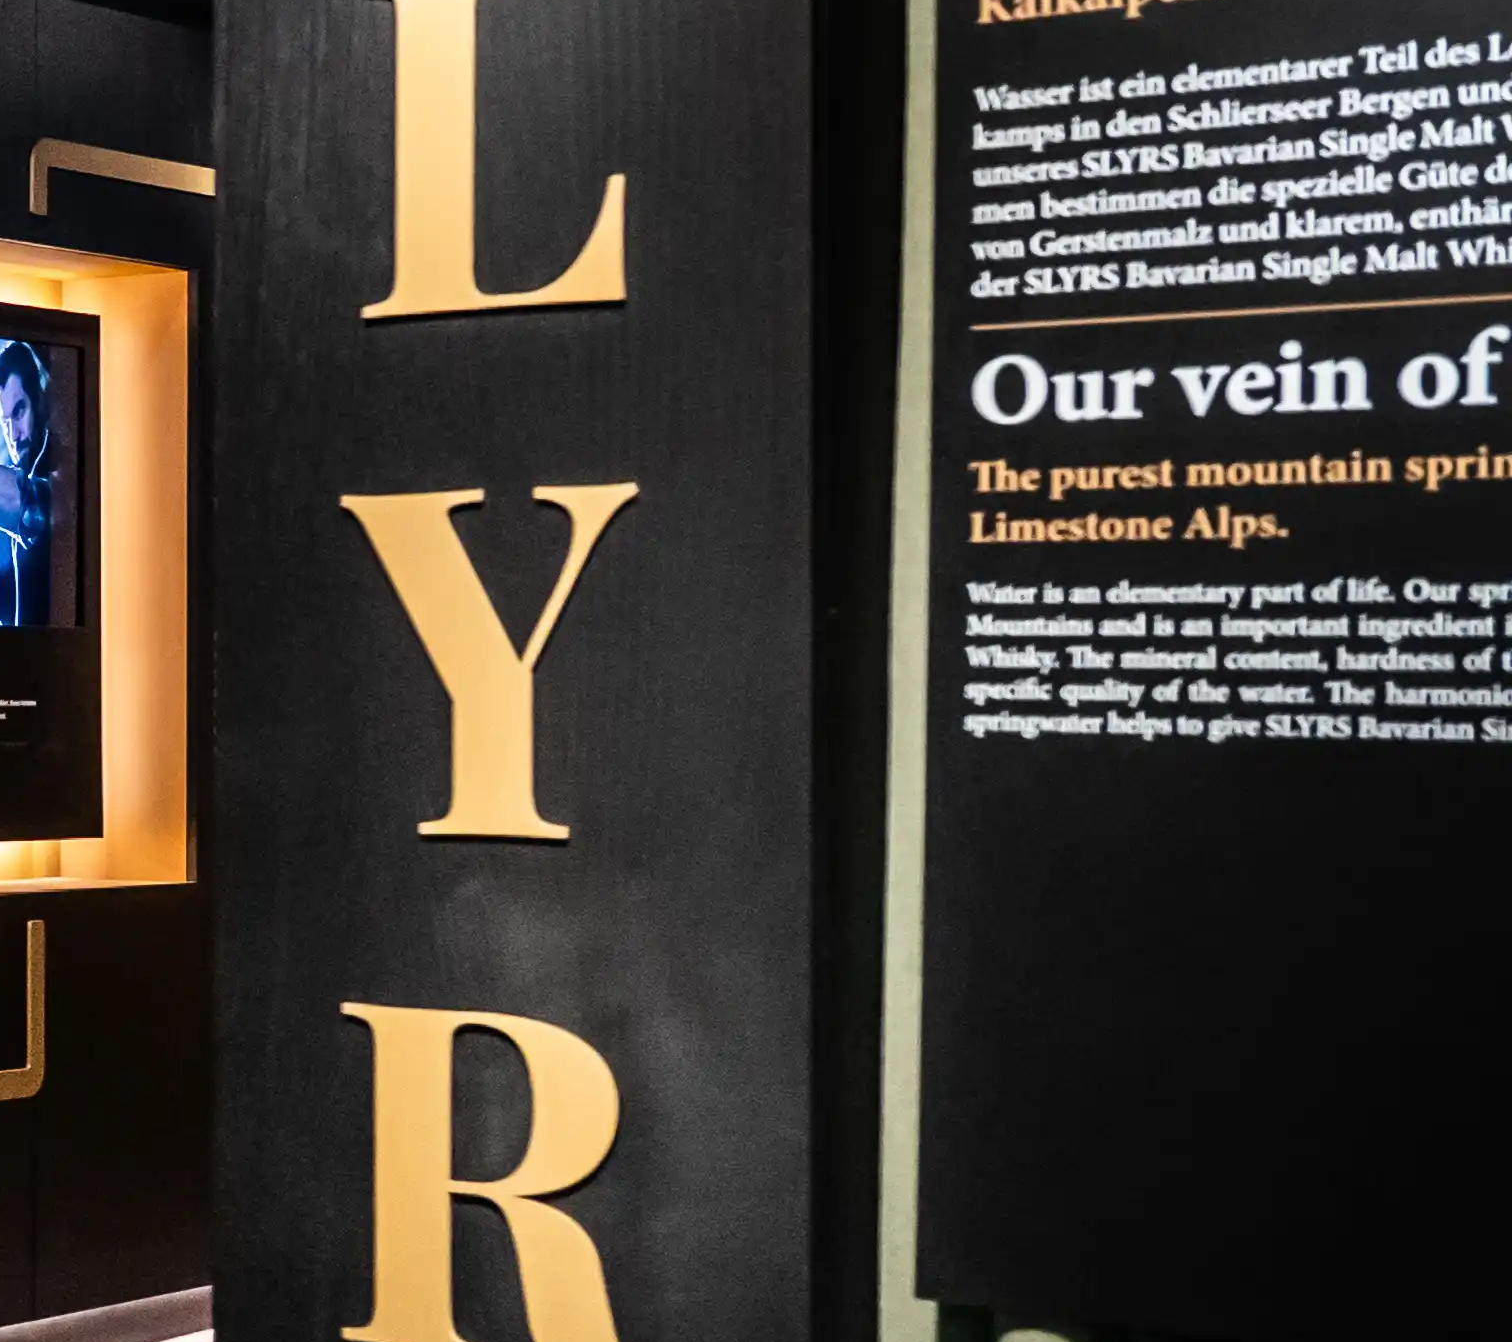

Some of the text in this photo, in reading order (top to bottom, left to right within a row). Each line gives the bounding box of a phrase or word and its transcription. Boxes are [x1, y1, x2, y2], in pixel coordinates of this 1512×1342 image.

[973, 85, 1073, 113] Wasser
[1079, 77, 1113, 102] ist
[1119, 72, 1165, 99] ein
[1171, 54, 1353, 95] elementarer
[1357, 40, 1418, 76] Teil
[1424, 36, 1480, 71] des
[970, 273, 1020, 299] der
[1023, 262, 1120, 295] SLYRS
[1125, 256, 1256, 289] Bavarian
[1262, 248, 1357, 286] Single
[1363, 240, 1437, 274] Malt
[971, 323, 1512, 426] Our vein of
[969, 460, 1040, 493] The
[1050, 460, 1172, 501] purest
[1185, 450, 1392, 488] mountain
[969, 505, 1290, 550] Limestone Alps.
